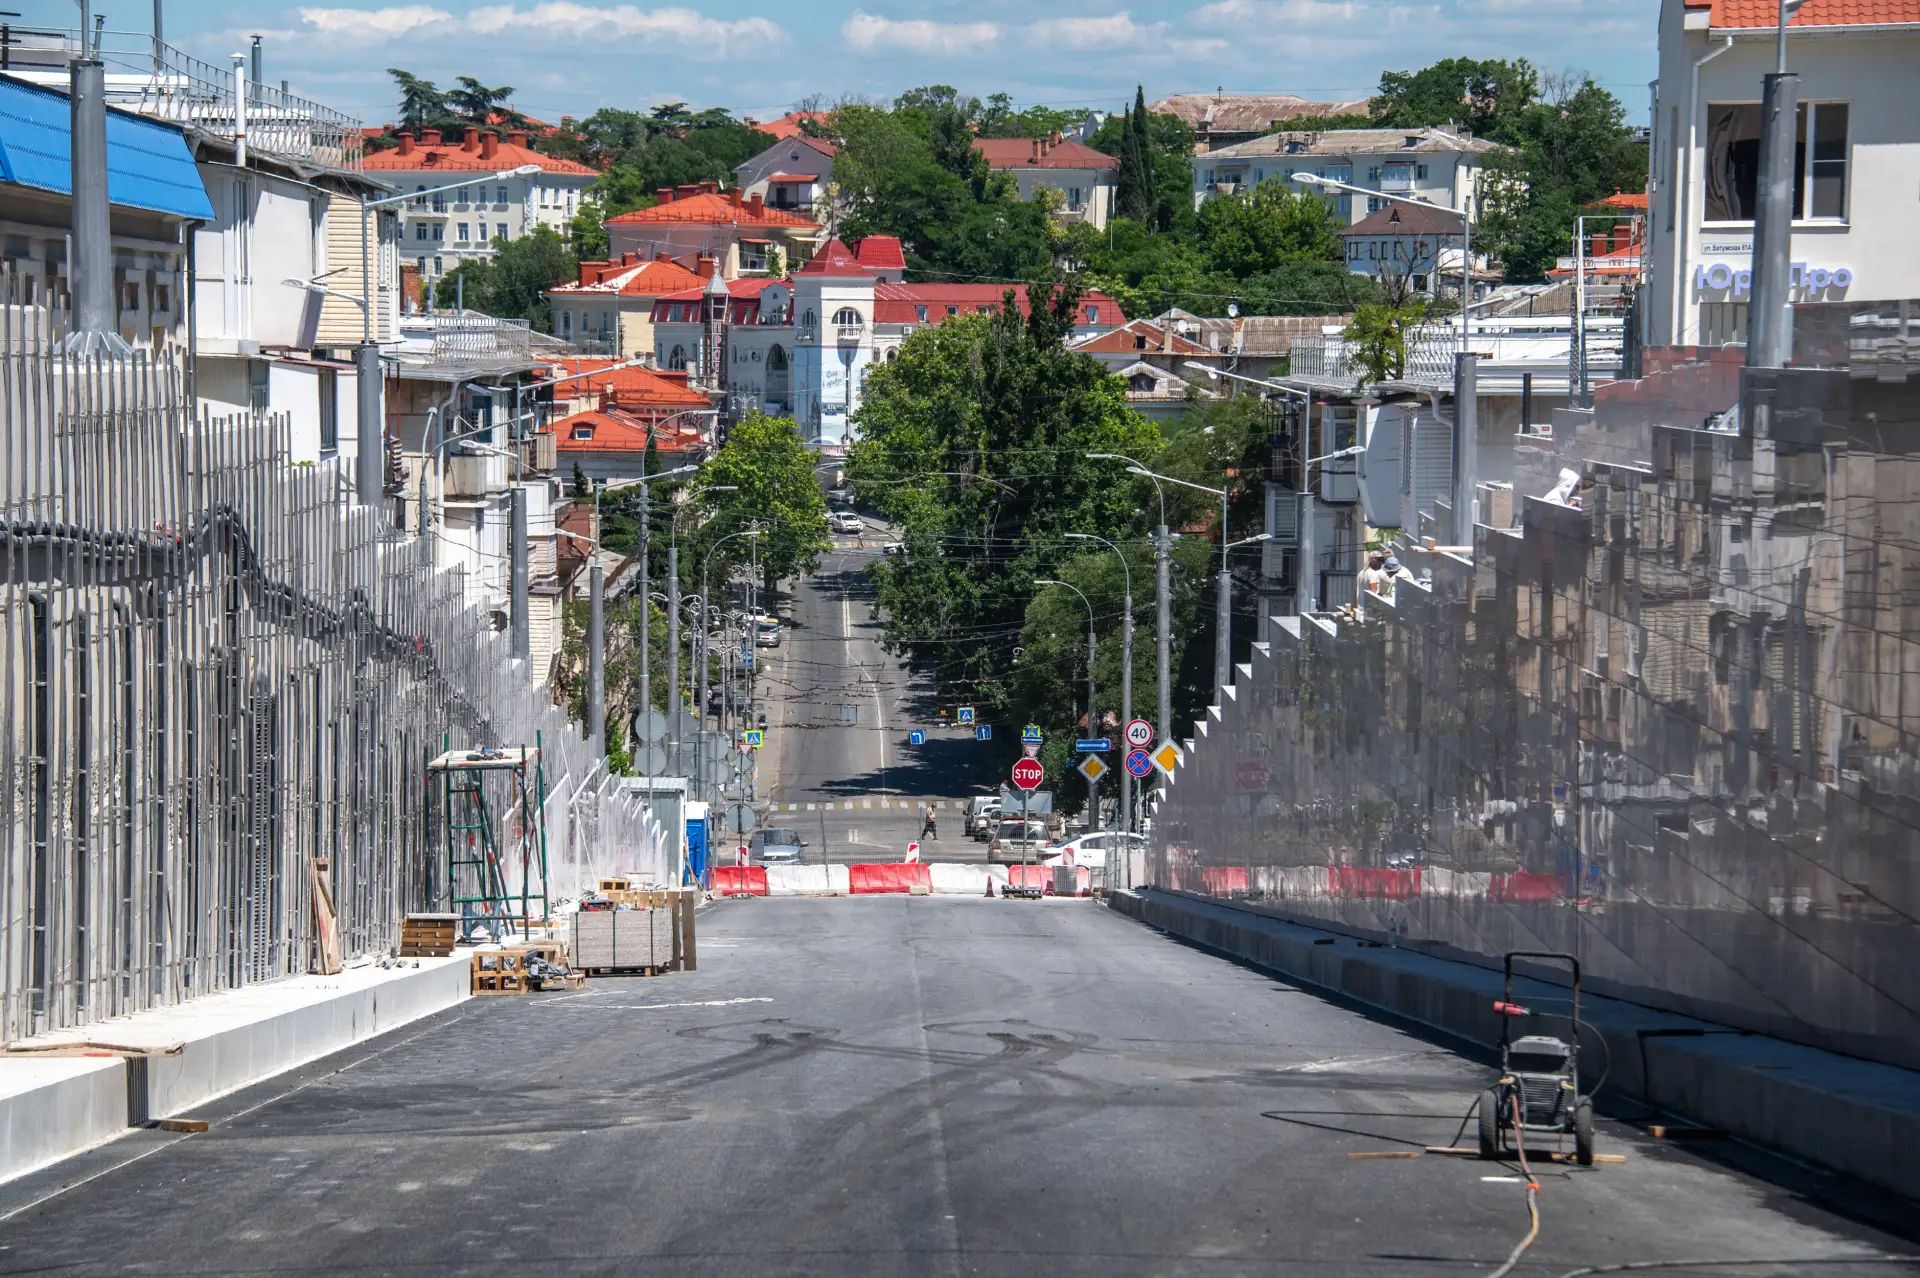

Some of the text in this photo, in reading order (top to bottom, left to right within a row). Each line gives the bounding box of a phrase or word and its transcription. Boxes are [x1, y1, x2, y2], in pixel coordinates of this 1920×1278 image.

[1712, 244, 1741, 252] Батумская
[1131, 728, 1147, 739] 40
[1014, 769, 1042, 779] STOP
